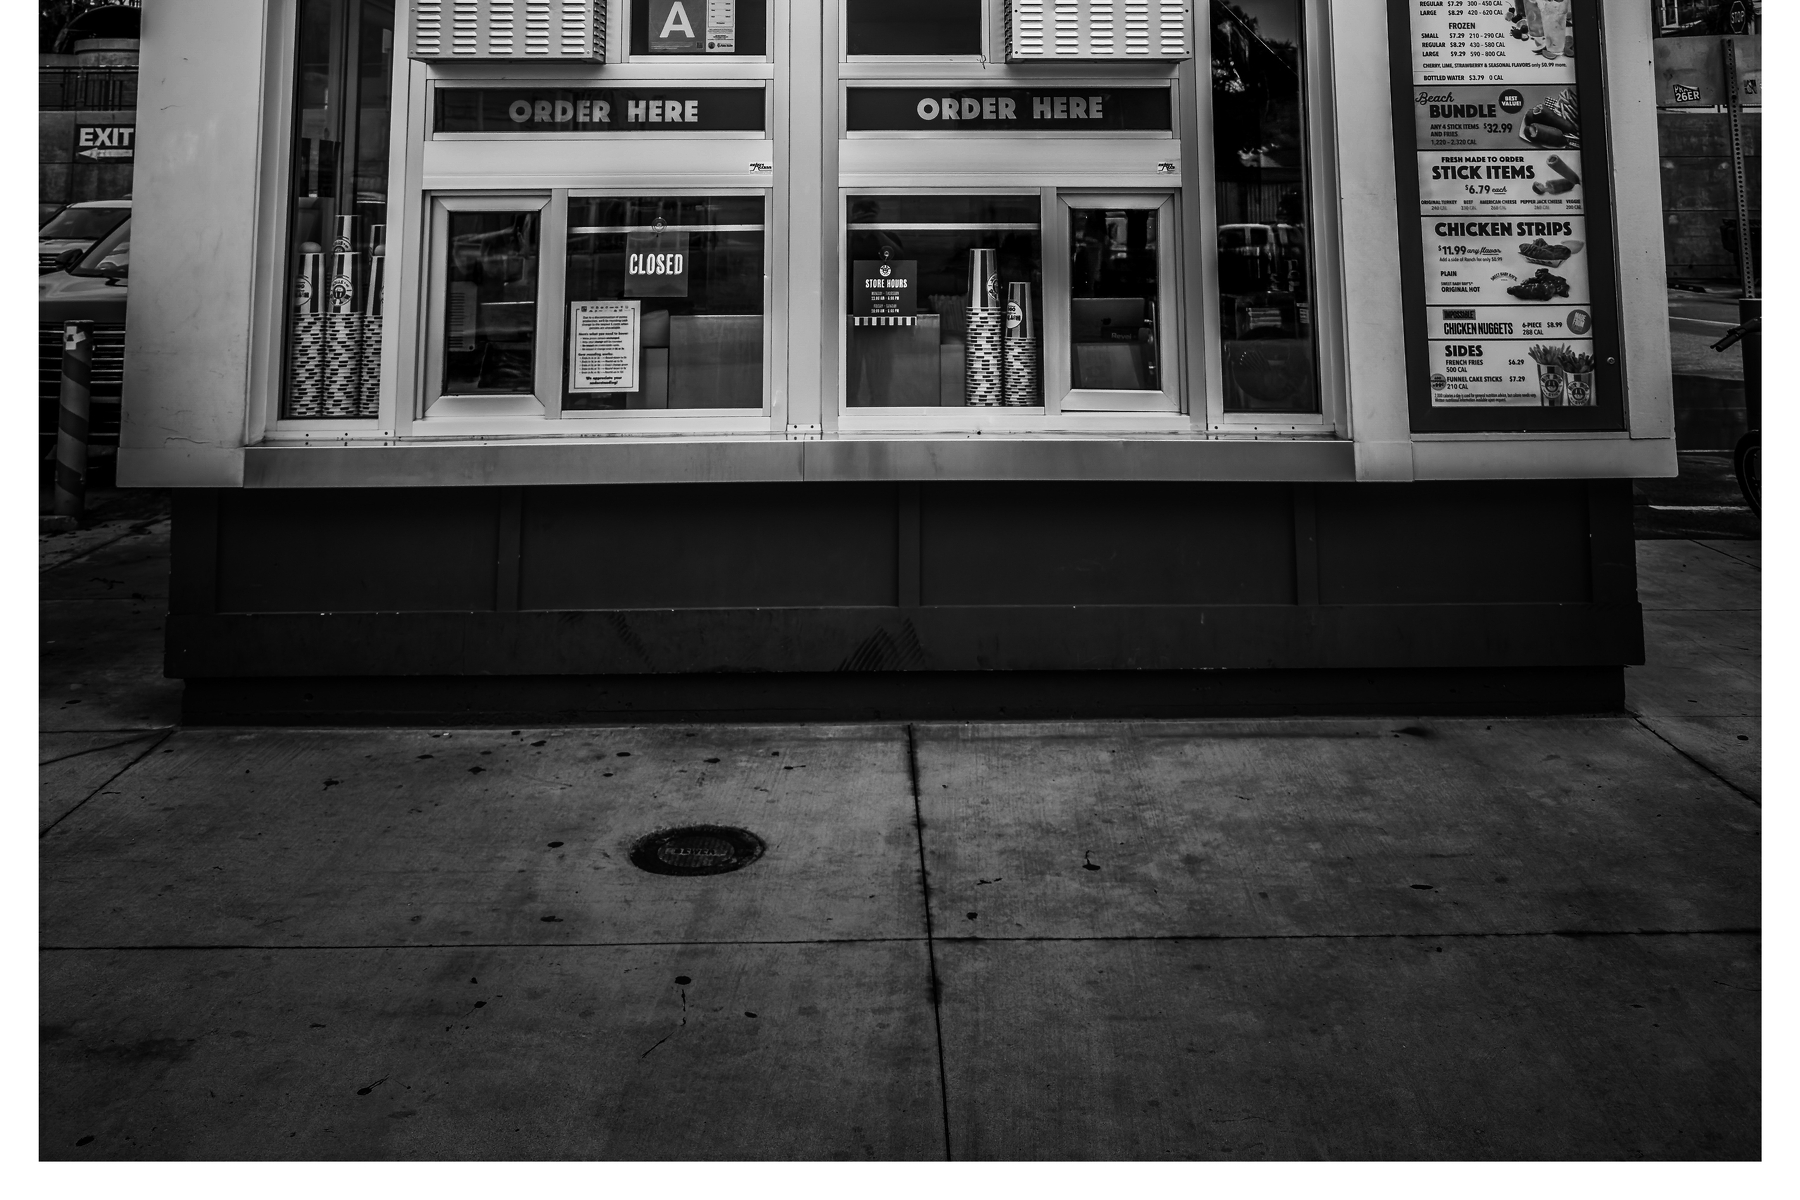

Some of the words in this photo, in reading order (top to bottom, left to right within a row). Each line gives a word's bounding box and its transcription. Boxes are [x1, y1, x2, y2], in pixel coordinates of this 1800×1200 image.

[660, 1, 695, 38] A
[1732, 10, 1744, 23] STOP
[1415, 92, 1454, 105] Beach
[509, 100, 610, 122] ORDER
[628, 100, 698, 122] HERE
[917, 98, 1016, 120] ORDER
[1033, 97, 1103, 118] HERE
[1430, 105, 1496, 118] BUNDLE
[1484, 123, 1512, 133] $32.99
[79, 128, 134, 146] EXIT
[1432, 166, 1482, 179] STICK
[1487, 165, 1534, 179] ITEMS
[1465, 185, 1490, 194] $6.79
[1435, 222, 1512, 236] CHICKEN
[1517, 222, 1572, 236] STRIPS
[1438, 245, 1466, 255] $11.99
[1480, 246, 1501, 255] flavor
[629, 254, 683, 275] CLOSED
[865, 279, 884, 288] STORE
[887, 279, 907, 288] HOURS
[1444, 323, 1478, 334] CHICKEN
[1479, 323, 1513, 334] NUGGETS
[1445, 345, 1483, 357] SIDES
